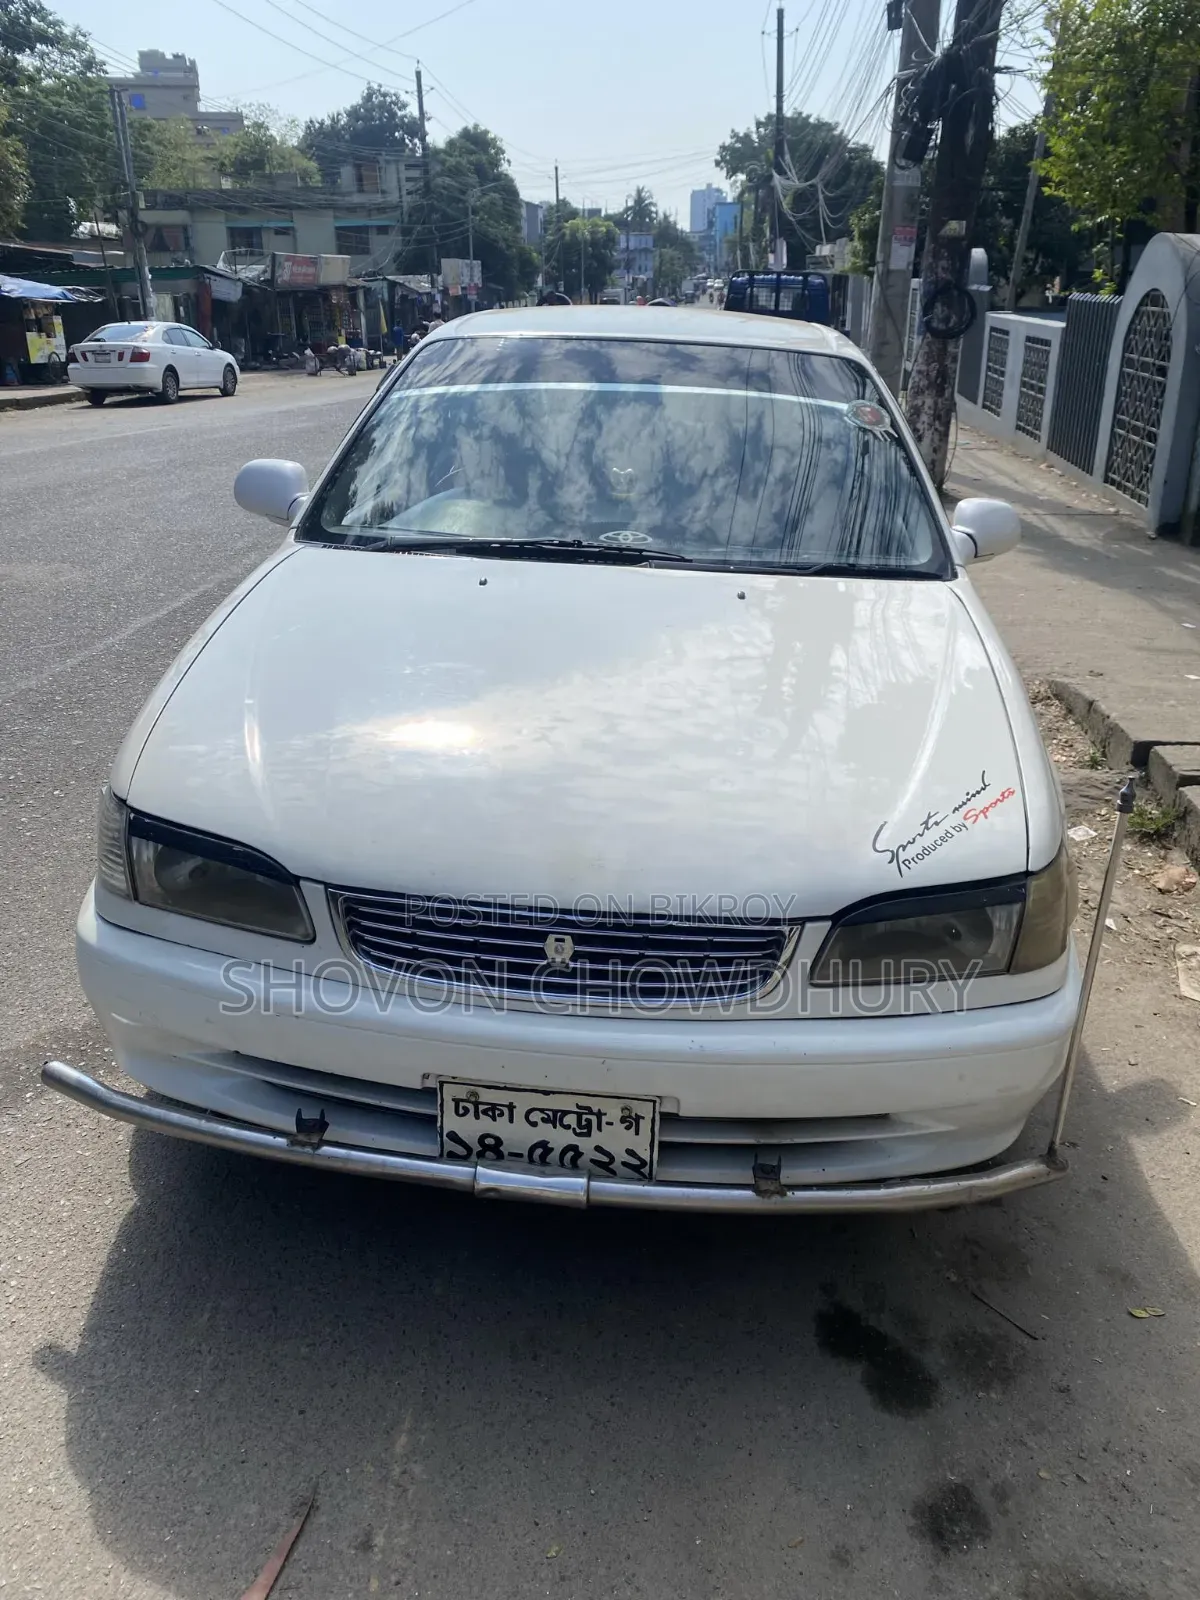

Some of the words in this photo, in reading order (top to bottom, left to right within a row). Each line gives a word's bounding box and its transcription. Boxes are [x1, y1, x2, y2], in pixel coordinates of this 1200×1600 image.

[872, 812, 949, 878] Sports
[952, 770, 991, 814] mind
[901, 829, 955, 870] Produced
[949, 822, 970, 833] by
[963, 787, 1015, 824] Sports
[451, 1097, 517, 1124] ঢাকা
[524, 1103, 645, 1137] মেট্রো-গ
